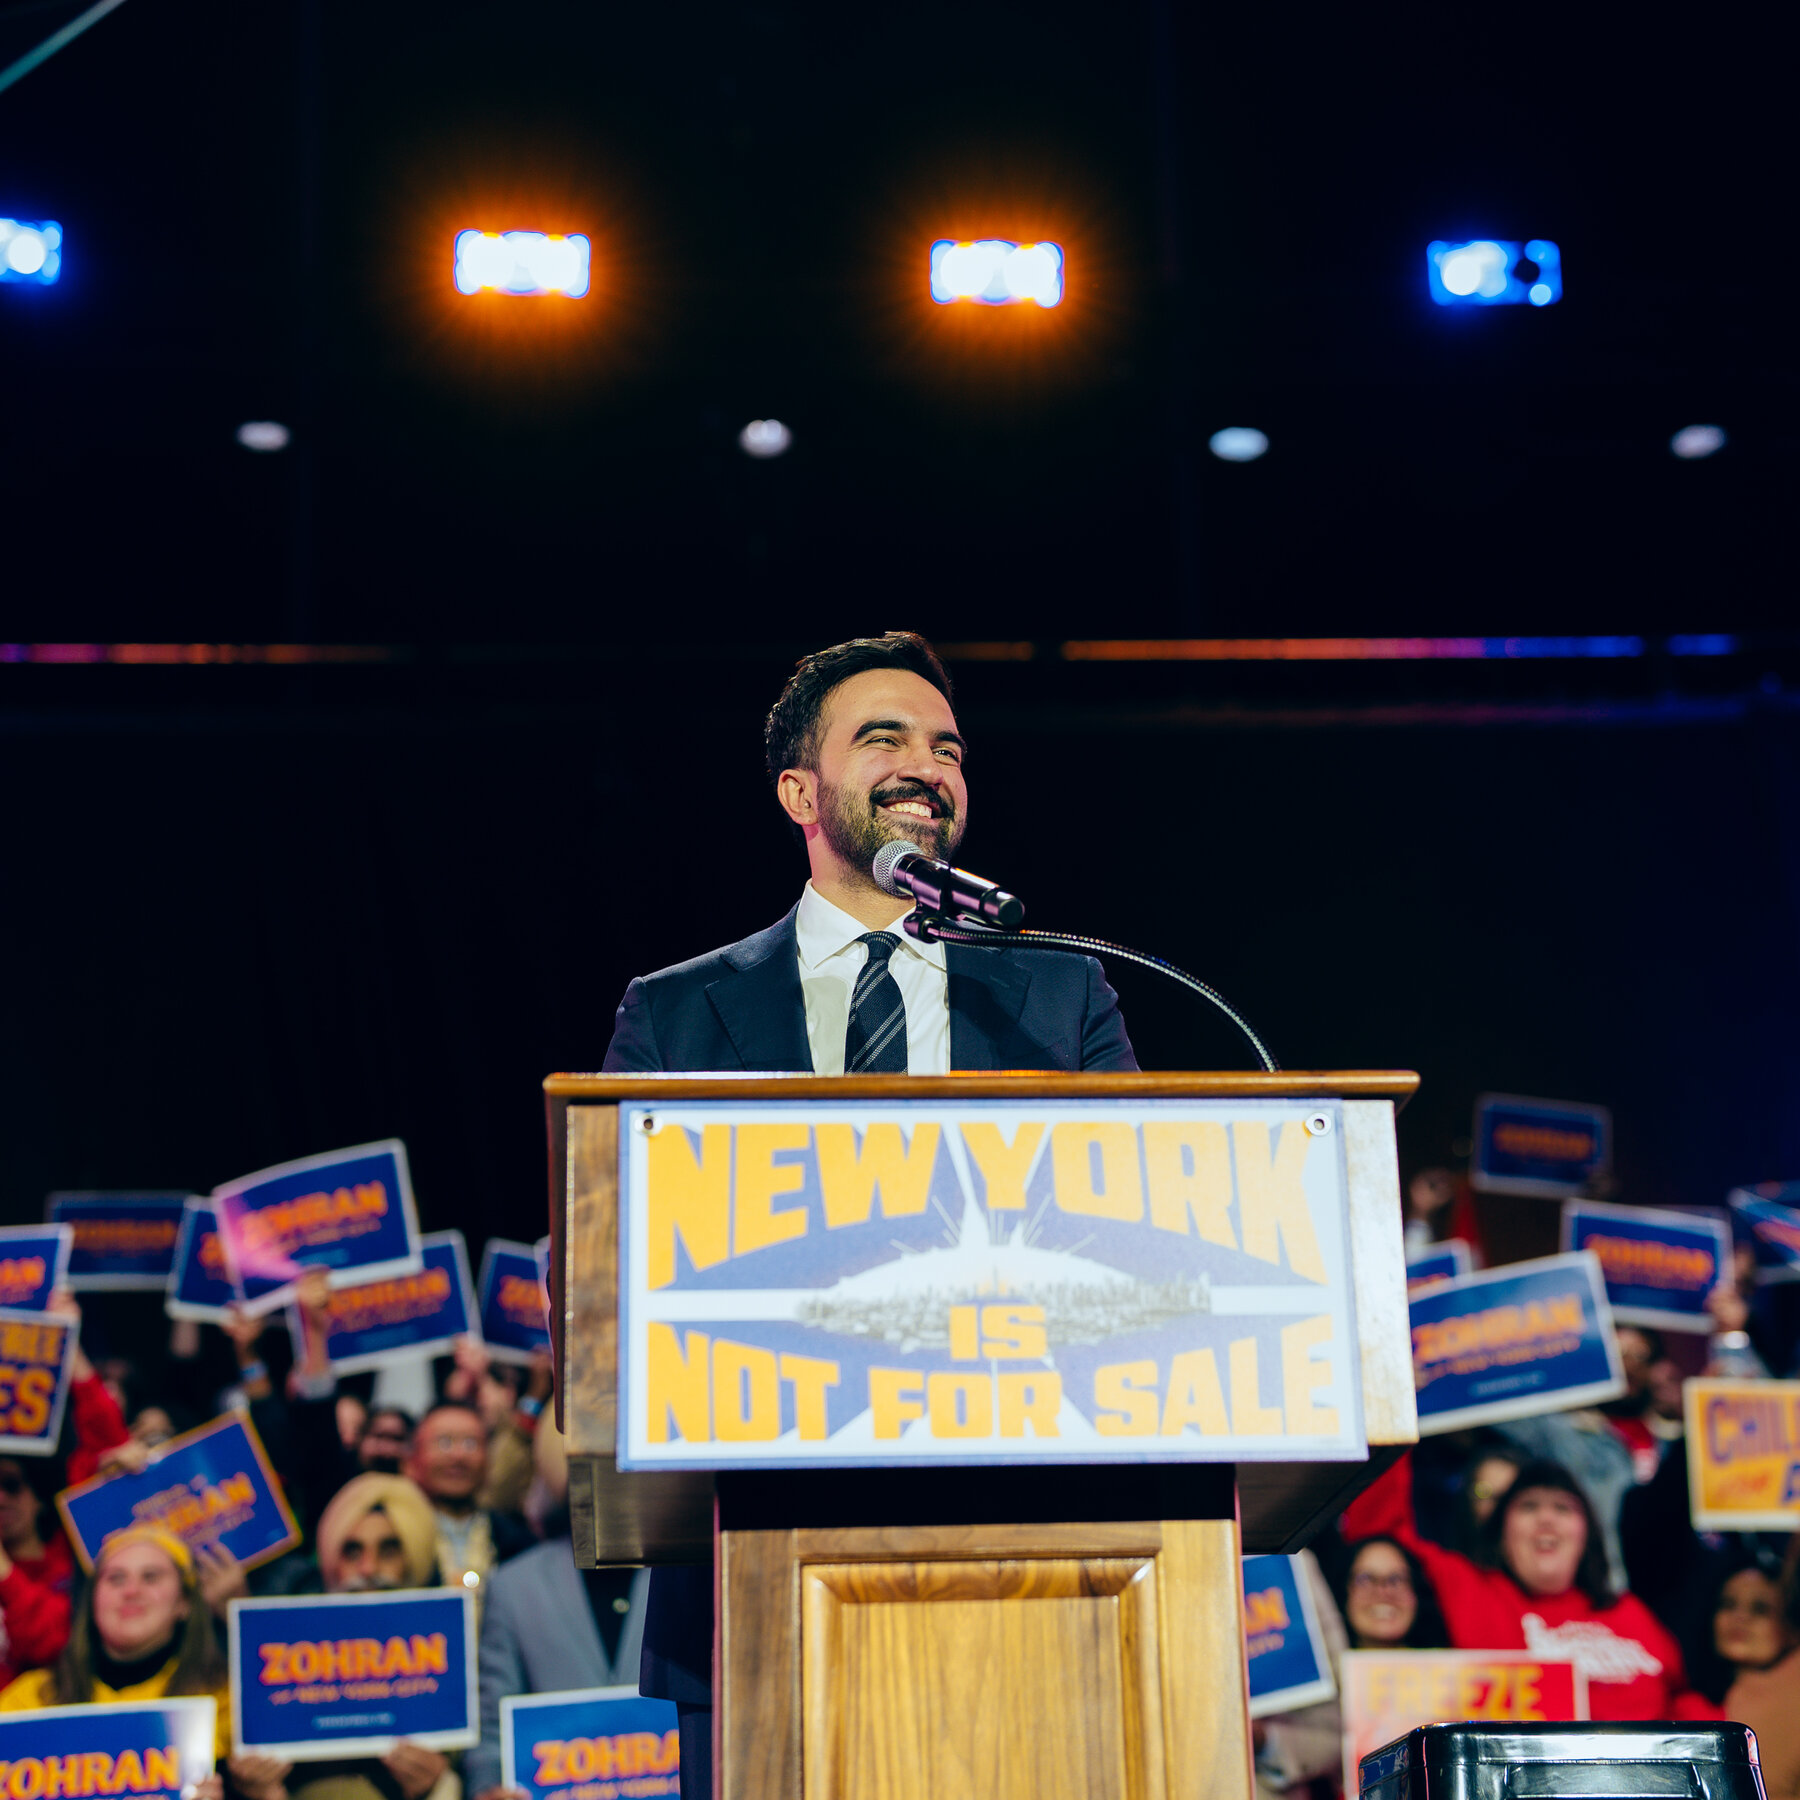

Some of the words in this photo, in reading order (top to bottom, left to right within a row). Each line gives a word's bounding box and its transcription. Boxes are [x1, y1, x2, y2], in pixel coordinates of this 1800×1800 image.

[647, 1122, 942, 1291] NEW
[958, 1121, 1329, 1286] YORK
[949, 1306, 1047, 1360] IS
[647, 1321, 839, 1443] NOT
[869, 1366, 1062, 1440] FOR
[1095, 1314, 1340, 1437] SALE
[259, 1632, 448, 1686] ZOHRAN
[1368, 1662, 1547, 1720] FREEZE
